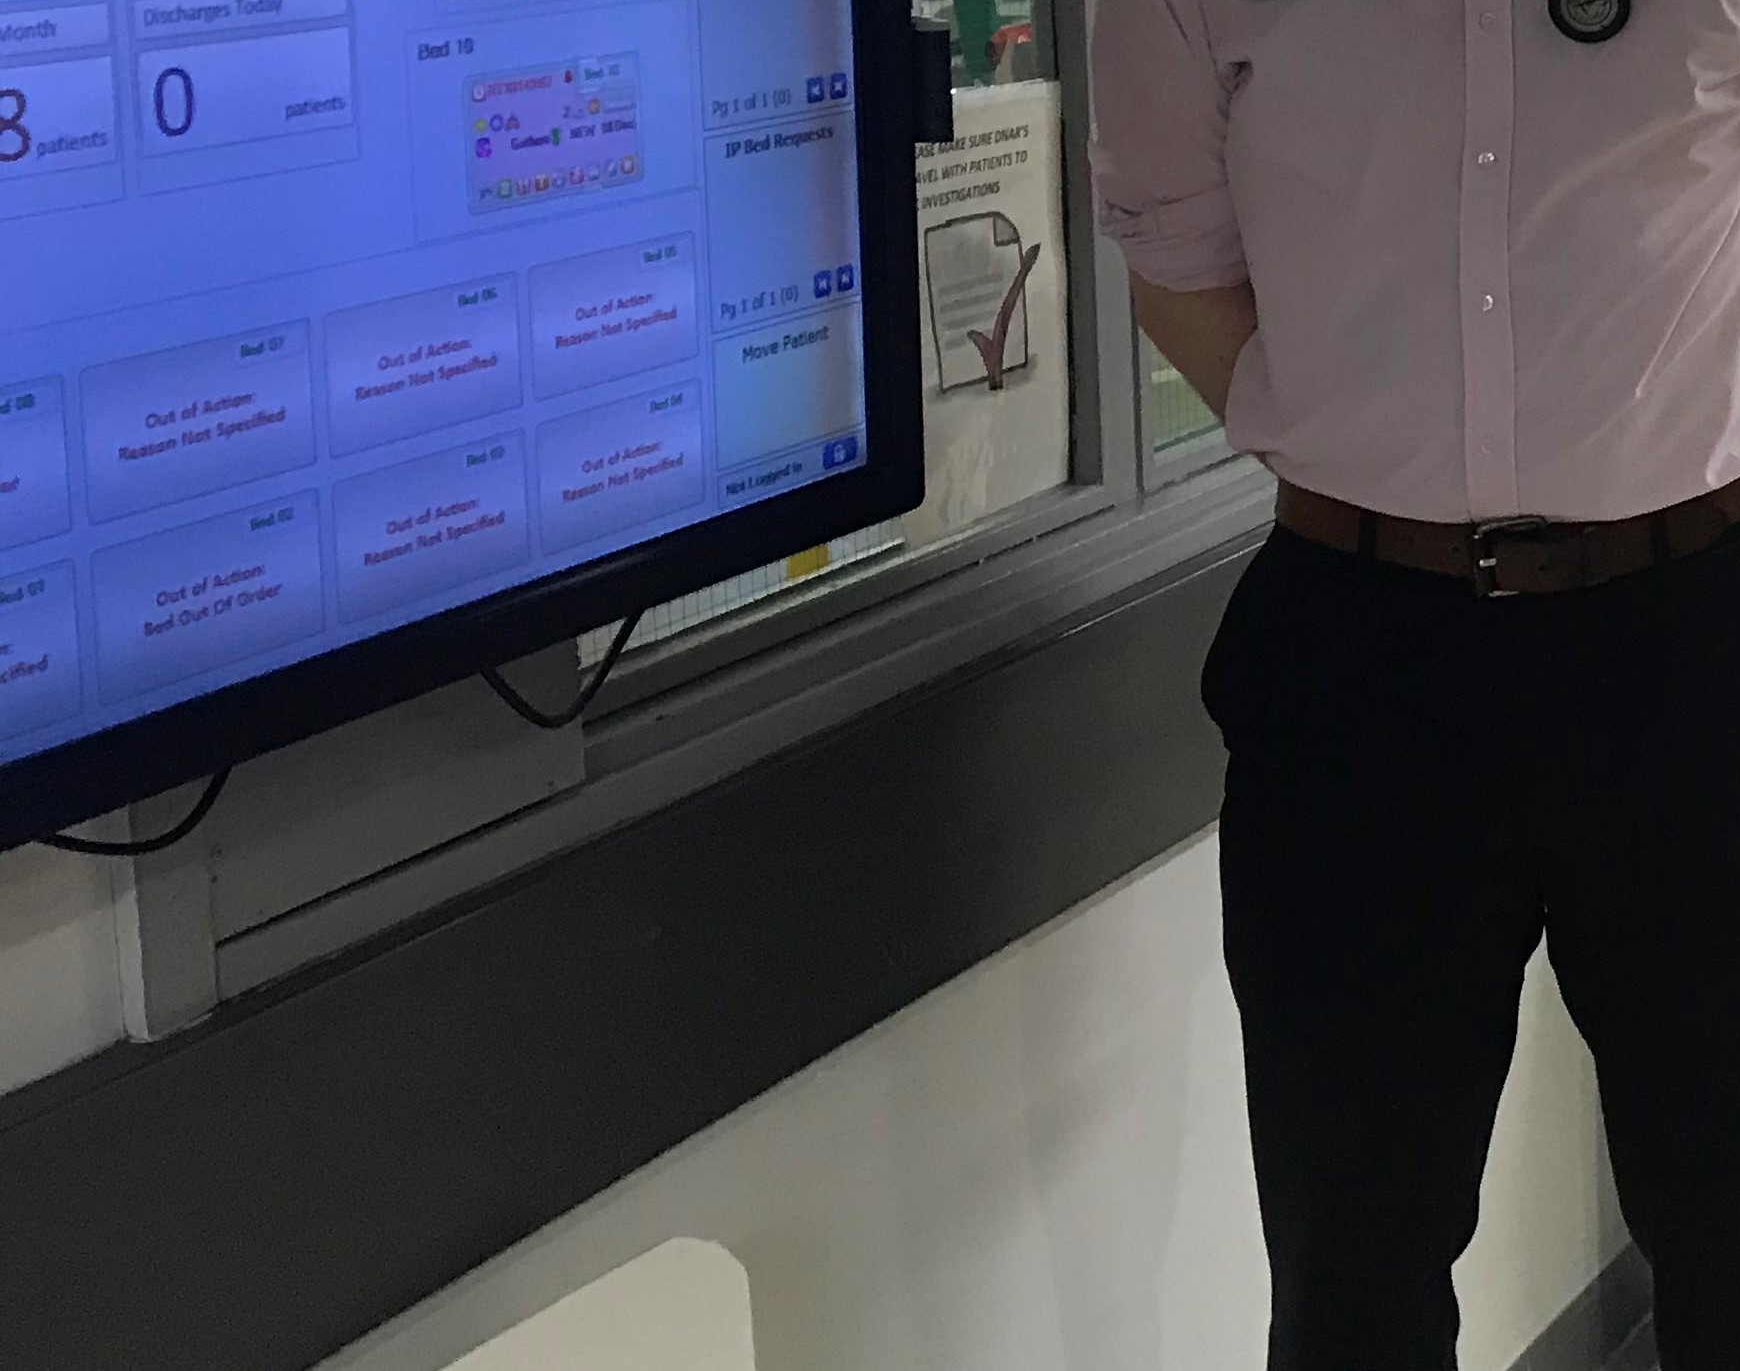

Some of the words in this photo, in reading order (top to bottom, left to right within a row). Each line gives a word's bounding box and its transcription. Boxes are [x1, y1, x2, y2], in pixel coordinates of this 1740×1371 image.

[143, 0, 231, 27] Discharges
[417, 40, 450, 61] Bed
[154, 66, 195, 137] 0
[285, 96, 346, 121] patients
[712, 99, 728, 118] Pg
[36, 132, 107, 160] patients
[744, 134, 770, 155] Bed
[774, 126, 834, 149] Requests
[938, 137, 966, 155] MAKE
[968, 132, 994, 149] SURE
[915, 169, 939, 184] AVEL
[941, 163, 968, 180] WITH
[968, 152, 1013, 174] PATIENTS
[1015, 150, 1028, 165] TO
[921, 181, 1001, 209] INVESTIGATIONS
[575, 306, 598, 321] Out
[720, 301, 736, 320] Pg
[555, 330, 598, 349] Reason
[601, 322, 622, 337] Not
[626, 307, 677, 332] Specified
[742, 342, 779, 363] Move
[782, 326, 829, 350] Patient
[378, 354, 405, 370] Out
[355, 380, 405, 401] Reason
[409, 370, 434, 387] Not
[438, 353, 497, 380] Specified
[145, 410, 176, 429] Out
[181, 402, 198, 420] of
[117, 438, 177, 461] Reason
[181, 428, 212, 447] Not
[216, 406, 287, 439] Specified
[562, 482, 604, 502] Reason
[608, 472, 630, 488] Not
[633, 451, 684, 480] Specified
[582, 458, 604, 473] Out
[364, 543, 413, 565] Reason
[416, 530, 443, 548] Not
[447, 510, 505, 540] Specified
[386, 517, 413, 534] Out
[155, 588, 186, 607] Out
[192, 577, 208, 597] of
[143, 613, 175, 637] Bed
[179, 606, 210, 625] Out
[236, 583, 283, 608] Order
